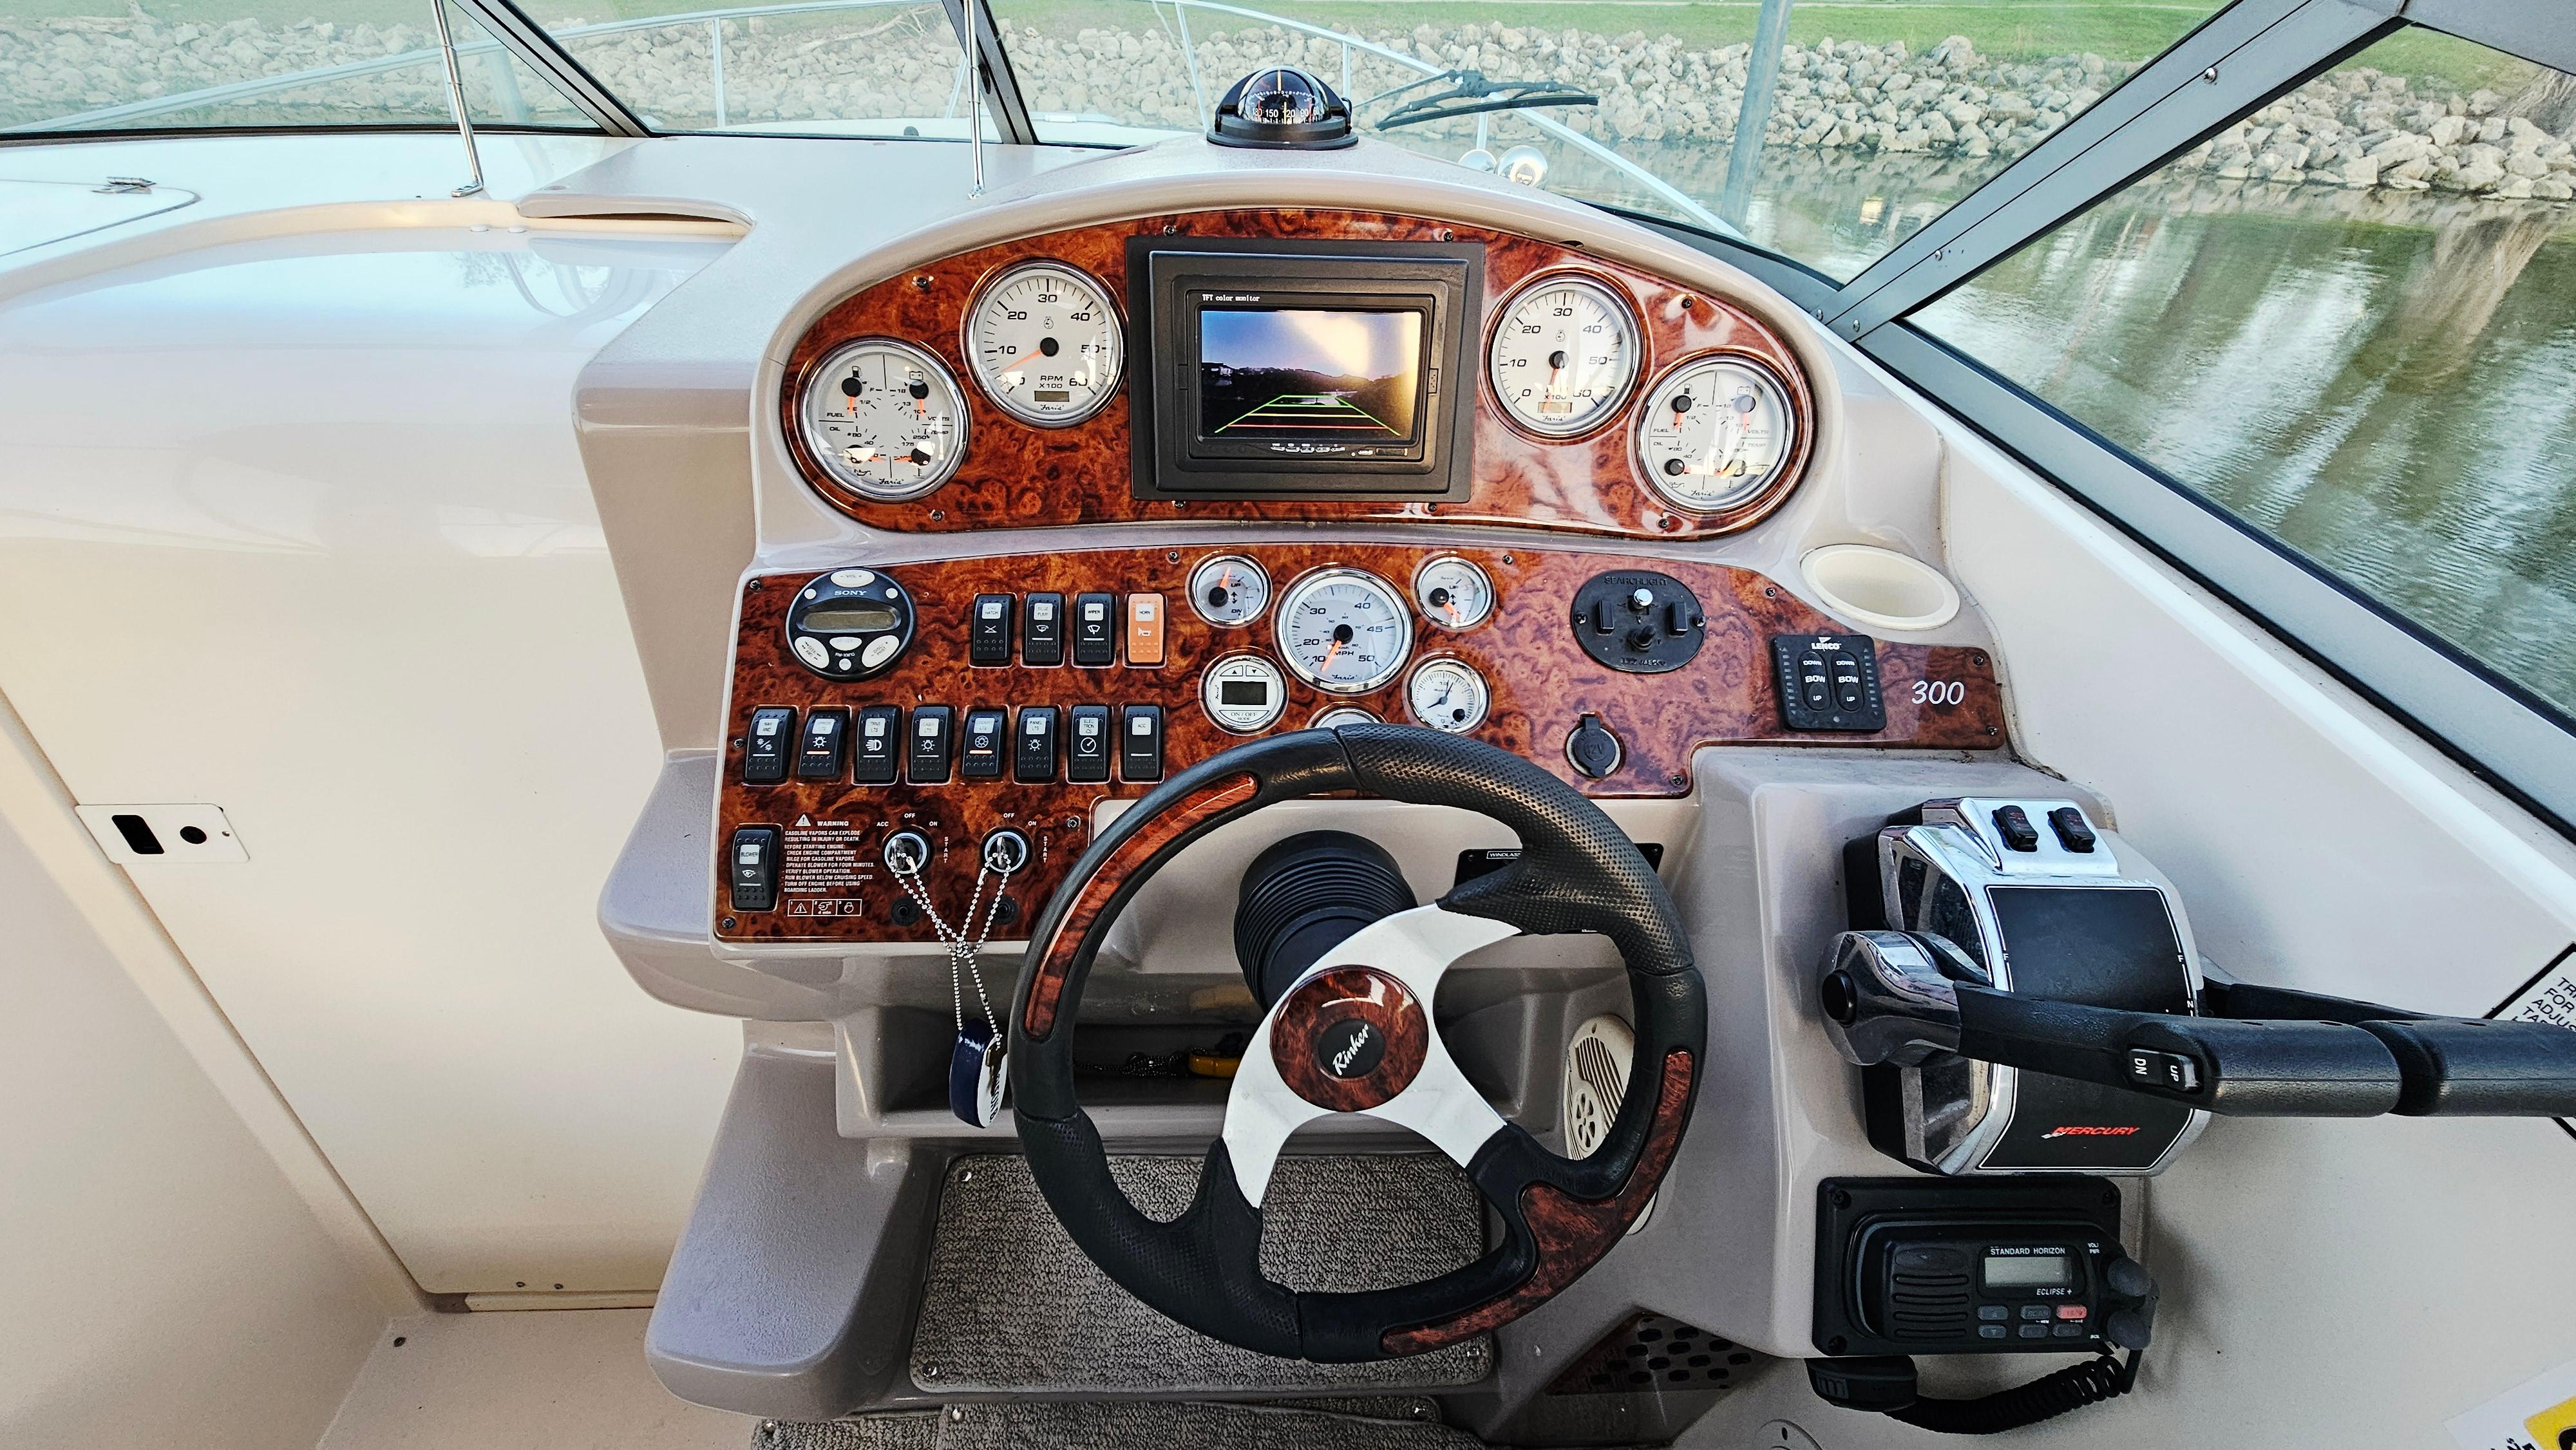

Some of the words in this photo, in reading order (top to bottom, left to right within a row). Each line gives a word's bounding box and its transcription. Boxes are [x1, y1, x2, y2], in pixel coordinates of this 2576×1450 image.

[1265, 109, 1279, 117] 150
[1285, 109, 1296, 117] 20
[1038, 294, 1057, 303] 30
[1007, 312, 1027, 320] 20
[1071, 312, 1090, 321] 40
[1553, 308, 1573, 317] 30
[1522, 325, 1541, 334] 20
[1583, 325, 1602, 334] 40
[998, 346, 1017, 354] 10
[1081, 344, 1100, 353] 50
[1522, 389, 1531, 397] 0
[1604, 576, 1667, 586] SEARCHLIGHT
[1911, 681, 1965, 705] 300
[2557, 977, 2576, 998] TR
[2544, 988, 2575, 1013] FOR
[1332, 1024, 1368, 1075] Rinker
[2134, 1058, 2147, 1075] DN
[2170, 1065, 2179, 1082] UP
[2052, 1126, 2140, 1136] MERCURY
